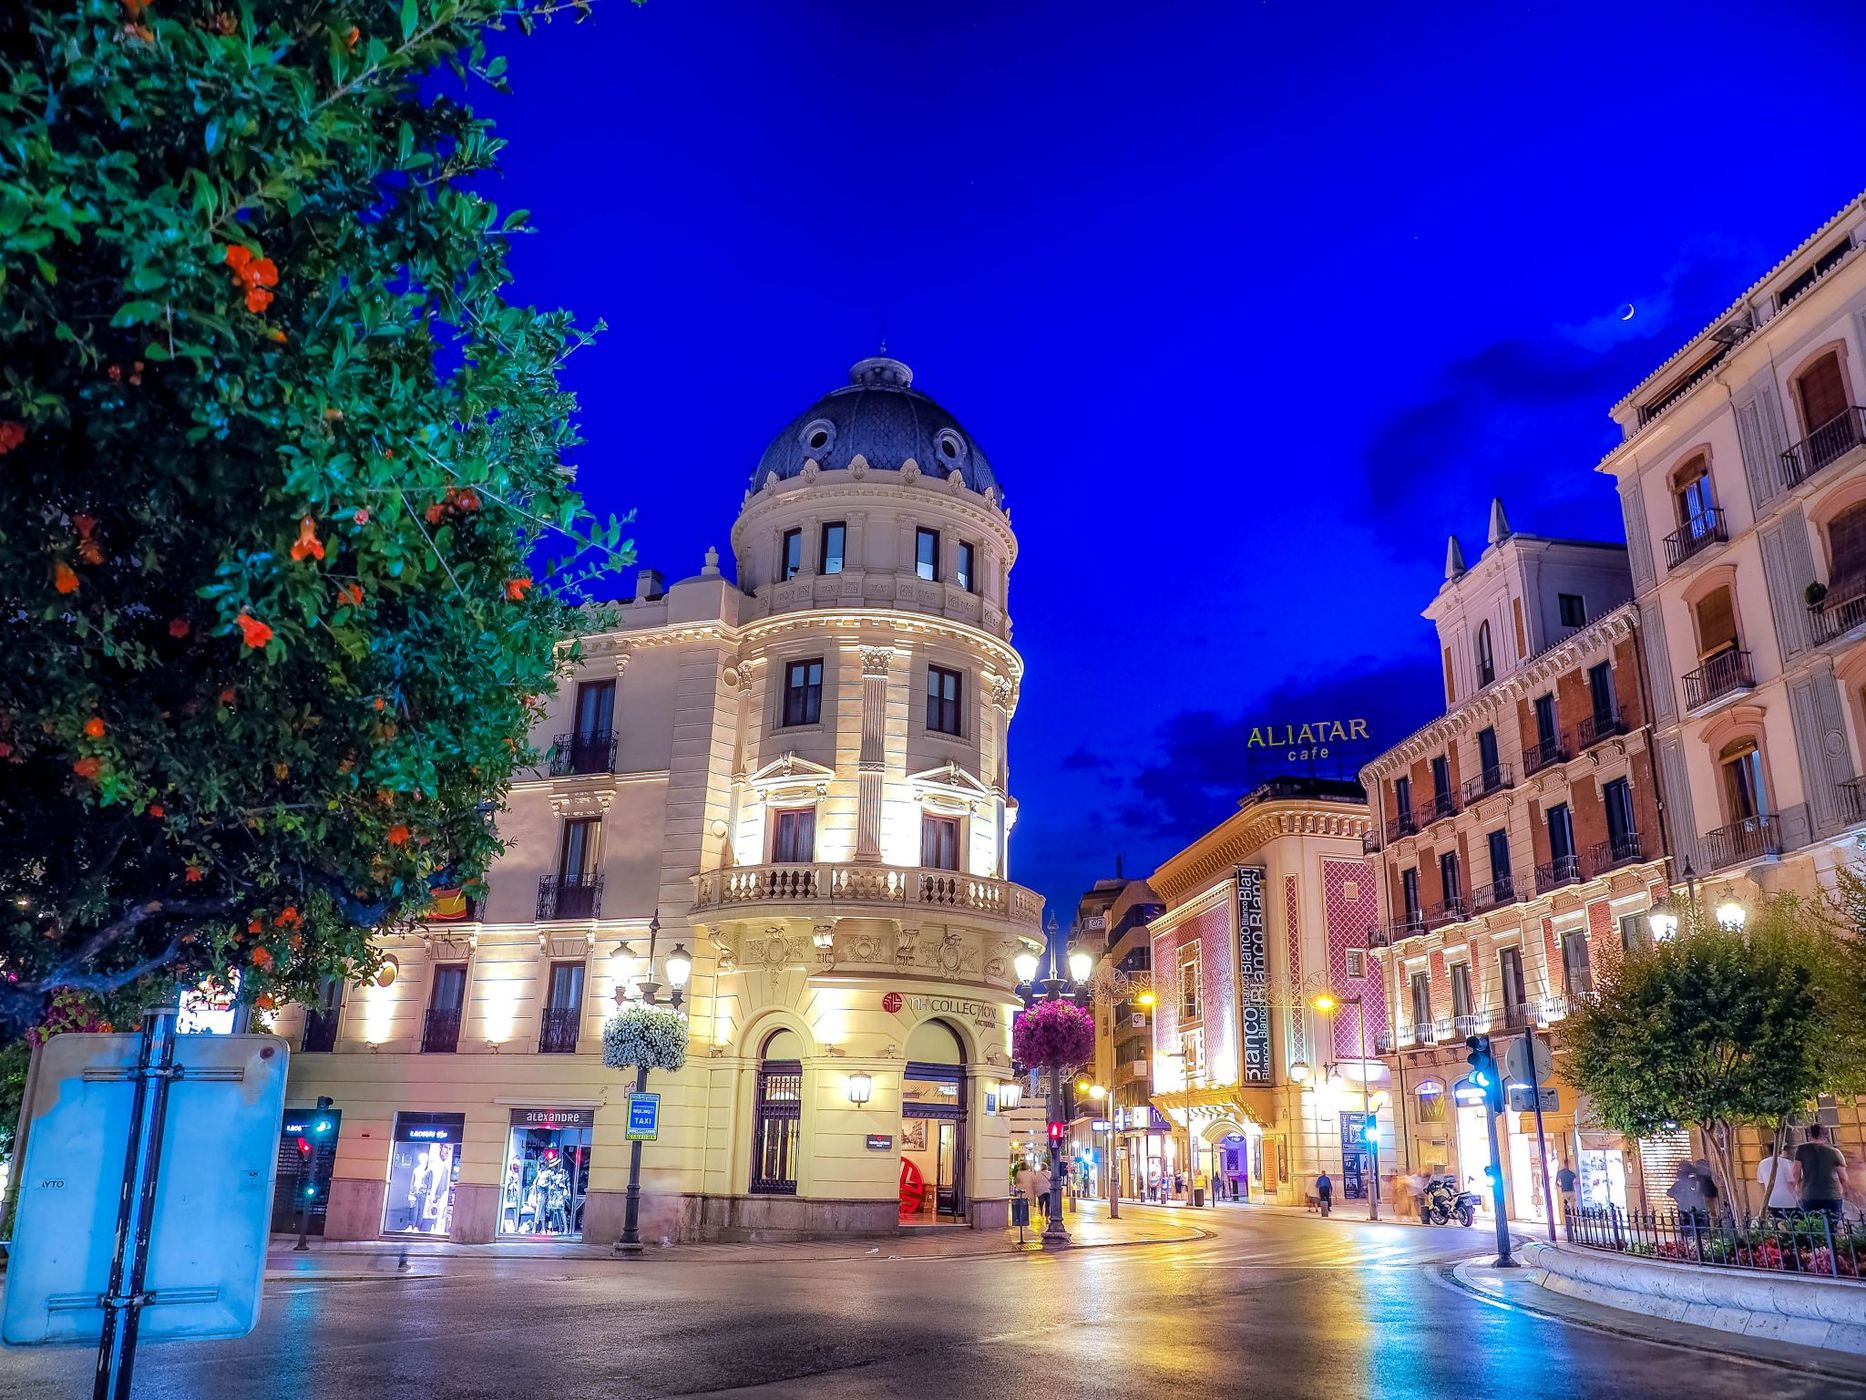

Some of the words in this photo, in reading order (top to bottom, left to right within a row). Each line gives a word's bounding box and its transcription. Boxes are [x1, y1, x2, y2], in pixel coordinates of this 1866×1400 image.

[1247, 719, 1370, 748] ALIATAR
[1288, 746, 1329, 761] cafe
[1241, 901, 1249, 926] Blanco
[1241, 927, 1252, 974] Blanco
[931, 1000, 997, 1019] COLLECTION
[1258, 1004, 1268, 1038] Blanco
[634, 1117, 652, 1125] TAXI
